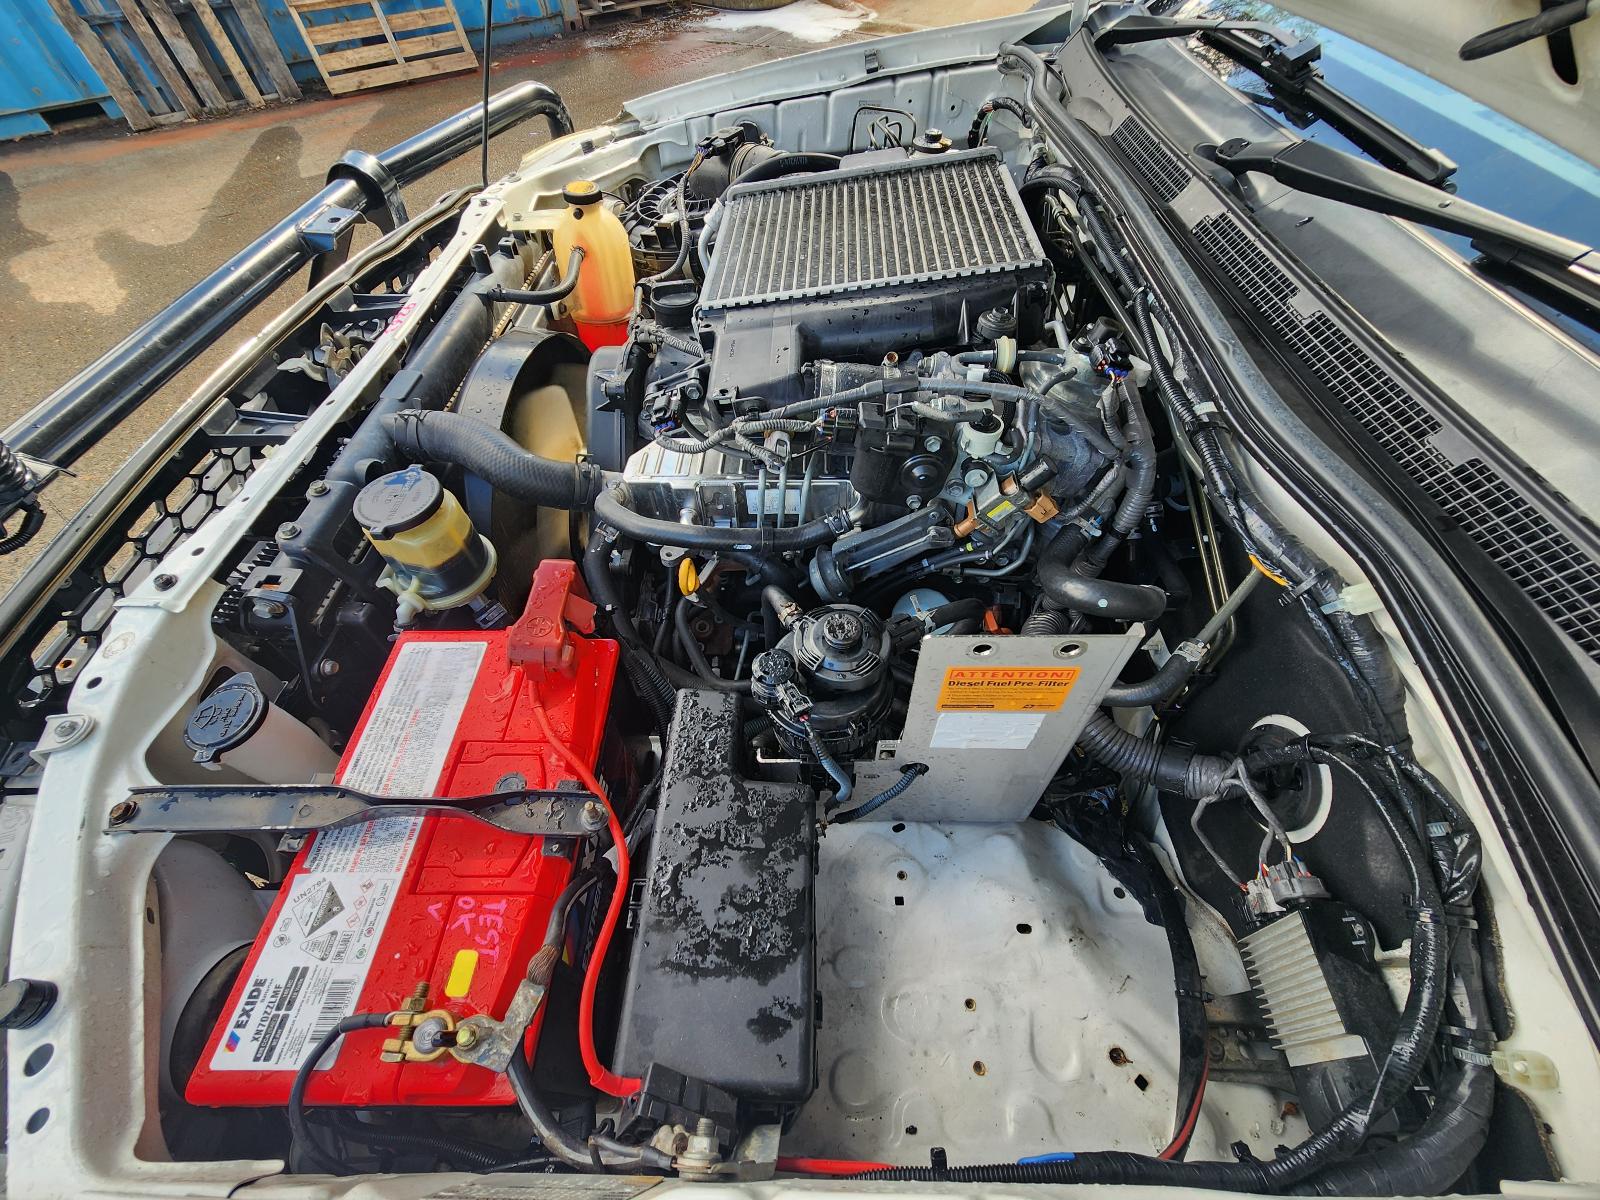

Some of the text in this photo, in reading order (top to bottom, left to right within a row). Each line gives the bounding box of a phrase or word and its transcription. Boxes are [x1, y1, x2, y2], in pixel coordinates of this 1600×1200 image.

[954, 671, 1073, 679] ATTENTION!
[450, 897, 477, 936] OK
[474, 899, 508, 968] TEST
[233, 978, 268, 1029] EXIDE
[251, 984, 283, 1041] XN70ZZLMF
